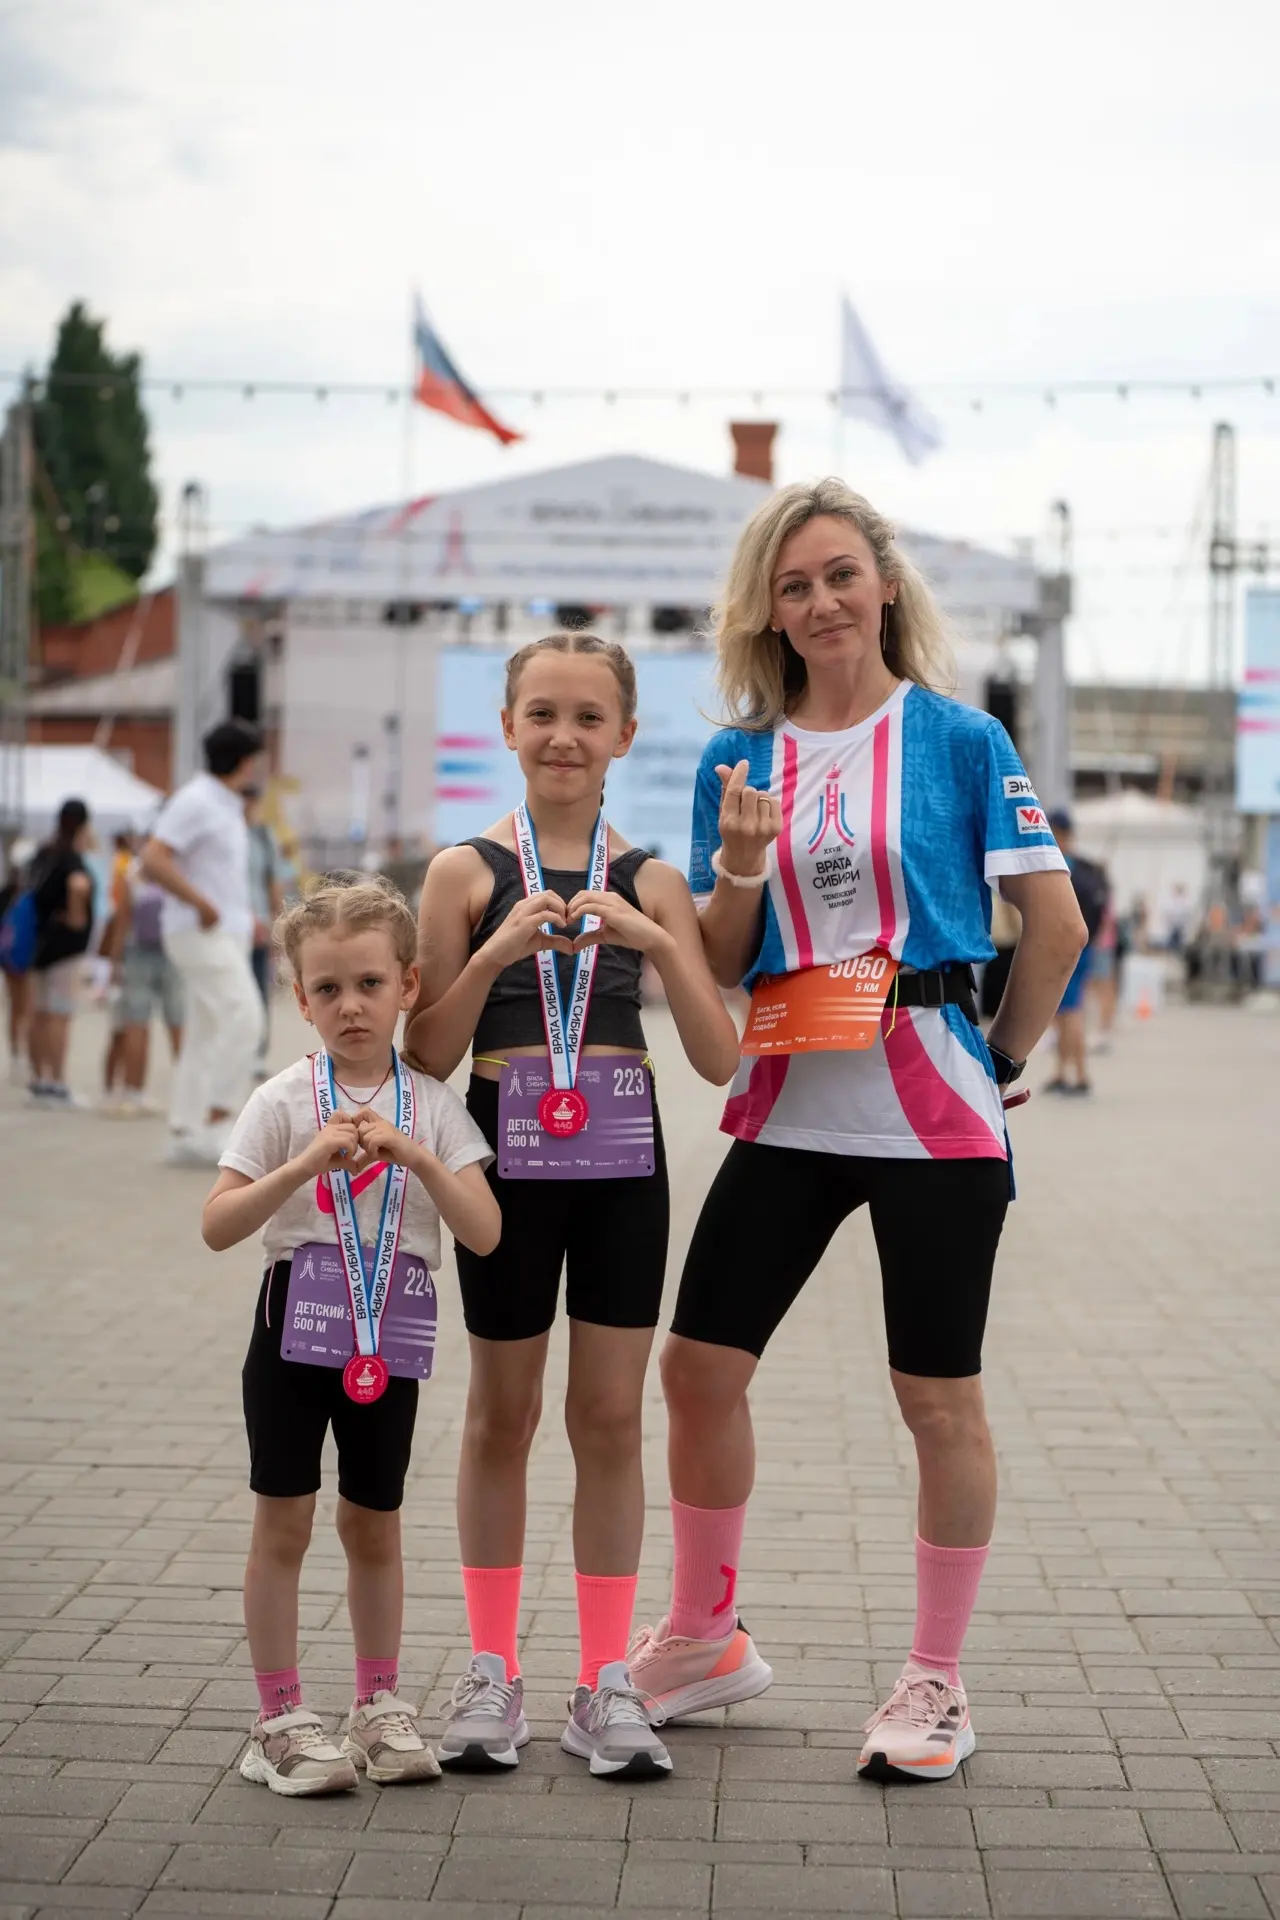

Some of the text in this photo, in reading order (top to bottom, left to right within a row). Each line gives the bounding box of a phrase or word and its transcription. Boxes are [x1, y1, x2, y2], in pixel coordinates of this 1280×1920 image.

[521, 838, 537, 881] СИБИРИ
[595, 843, 606, 872] ВРАТА
[816, 857, 852, 874] ВРАТА
[813, 869, 861, 889] СИБИРИ
[575, 969, 589, 1003] ВРАТА
[855, 982, 879, 992] 5 КМ
[542, 969, 563, 1054] ВРАТА СИБИРИ
[567, 1005, 583, 1053] СИБИРИ
[613, 1067, 645, 1096] 223
[402, 1090, 412, 1122] ВРАТА
[507, 1119, 545, 1133] ДЕТСК
[507, 1135, 539, 1147] 500 М
[380, 1231, 395, 1266] ВРАТА
[343, 1232, 366, 1320] ВРАТА СИБИРИ
[403, 1266, 433, 1298] 224
[371, 1269, 388, 1318] СИБИРИ
[293, 1316, 327, 1333] 500 М
[294, 1300, 345, 1320] ДЕТСКИЙ
